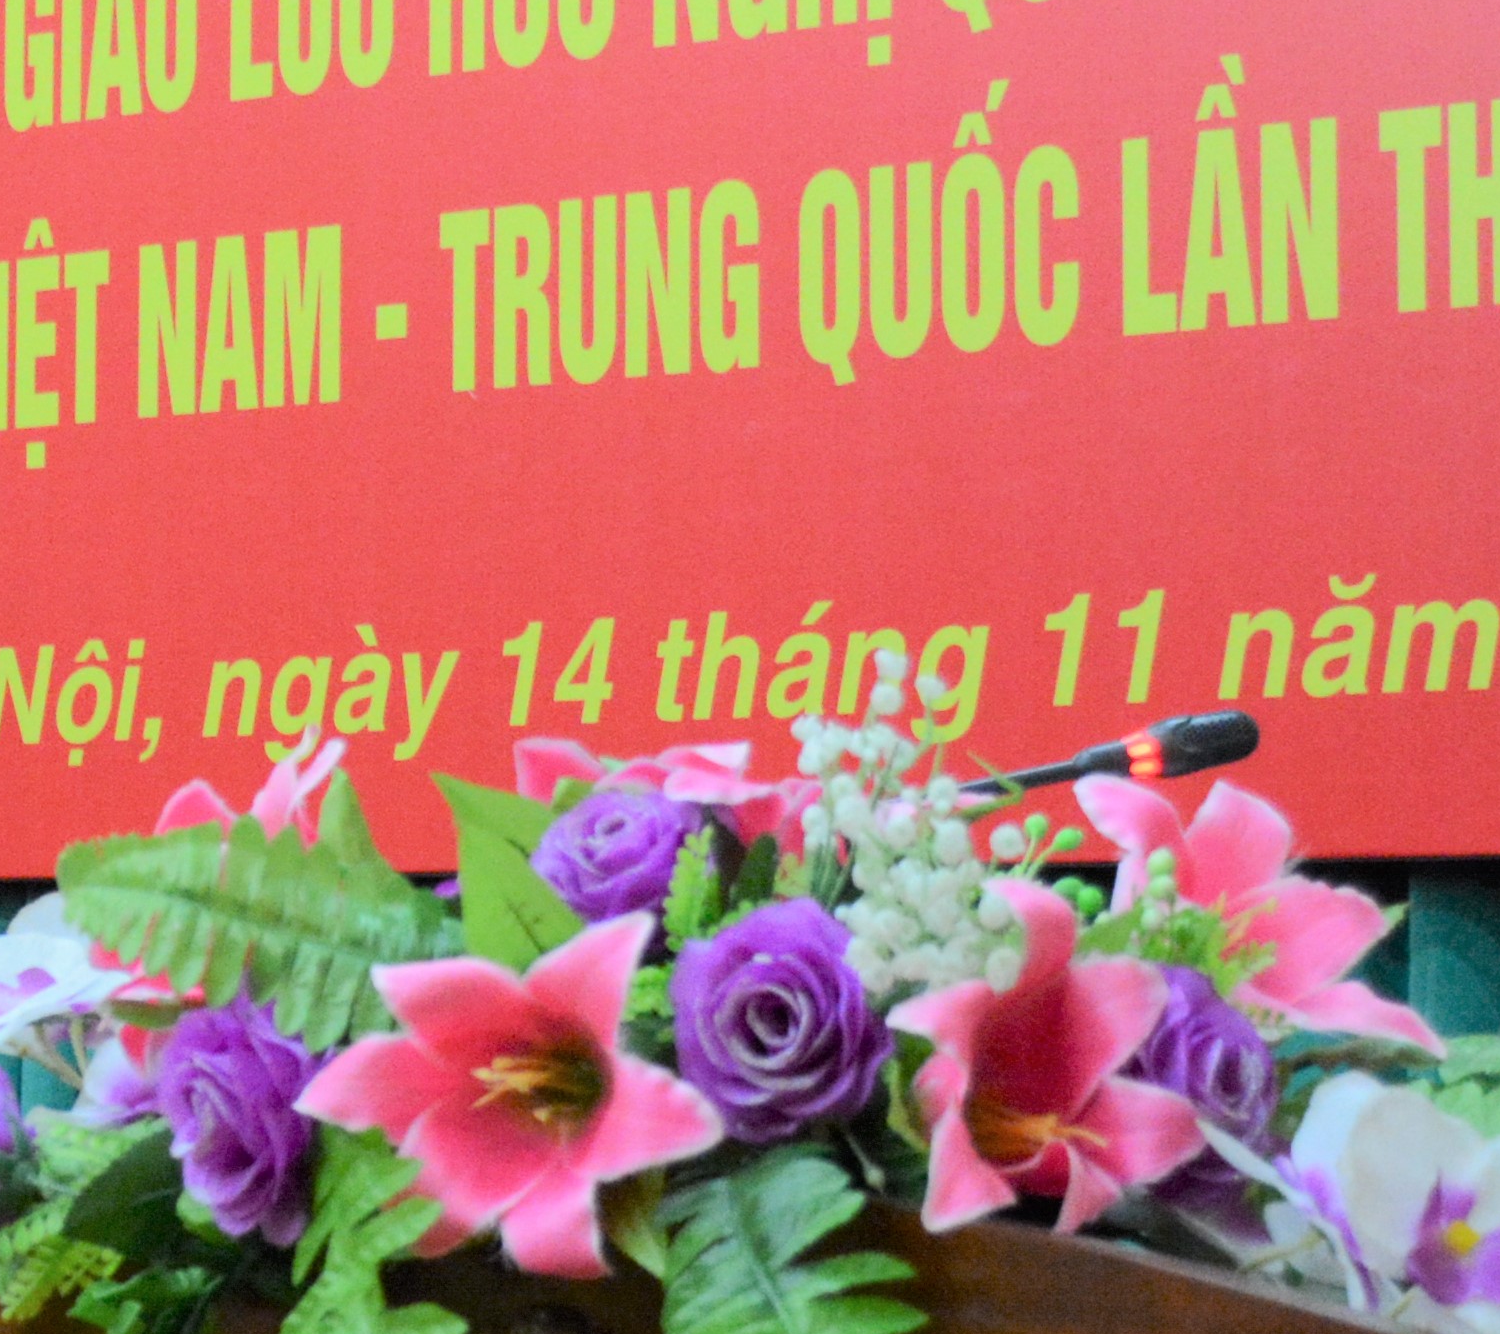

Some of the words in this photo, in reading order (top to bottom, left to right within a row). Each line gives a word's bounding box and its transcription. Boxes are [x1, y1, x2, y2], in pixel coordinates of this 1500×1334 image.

[137, 224, 343, 417] NAM
[377, 304, 408, 339] -
[440, 180, 761, 393] TRUNG
[798, 80, 1081, 386] QUỐC
[1121, 54, 1340, 337] LẦN
[203, 624, 459, 765] ngày
[503, 618, 615, 727] 14
[656, 600, 989, 752] tháng
[1045, 590, 1164, 707] 11
[1219, 573, 1500, 702] năm
